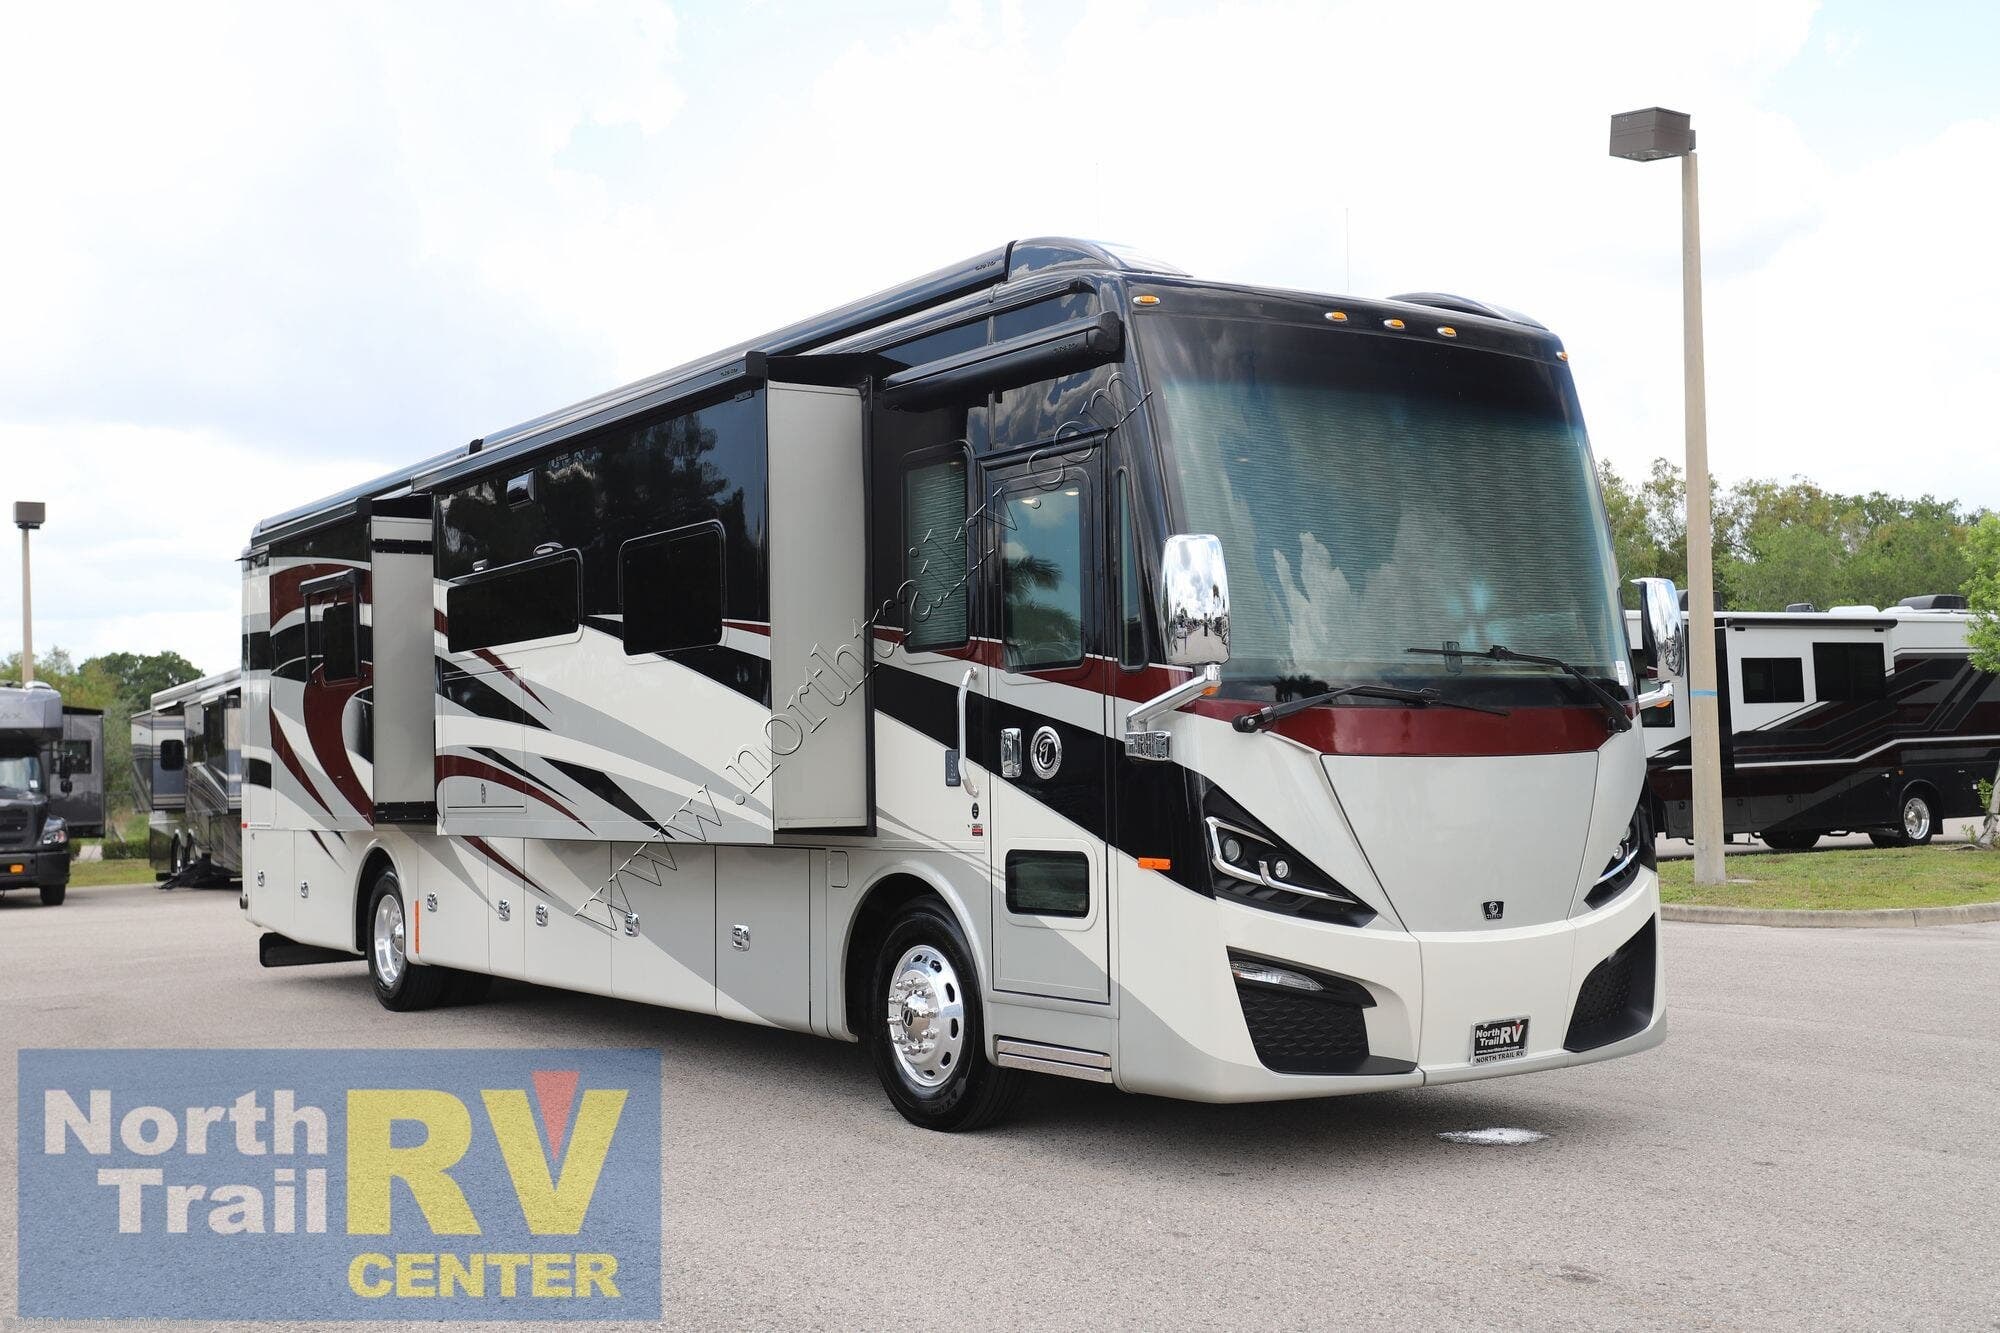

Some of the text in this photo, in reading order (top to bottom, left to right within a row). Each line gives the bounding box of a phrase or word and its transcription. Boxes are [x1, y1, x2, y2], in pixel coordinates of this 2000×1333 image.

[1476, 1028, 1500, 1038] North
[1500, 1024, 1524, 1044] RV
[1480, 1037, 1500, 1046] Trail
